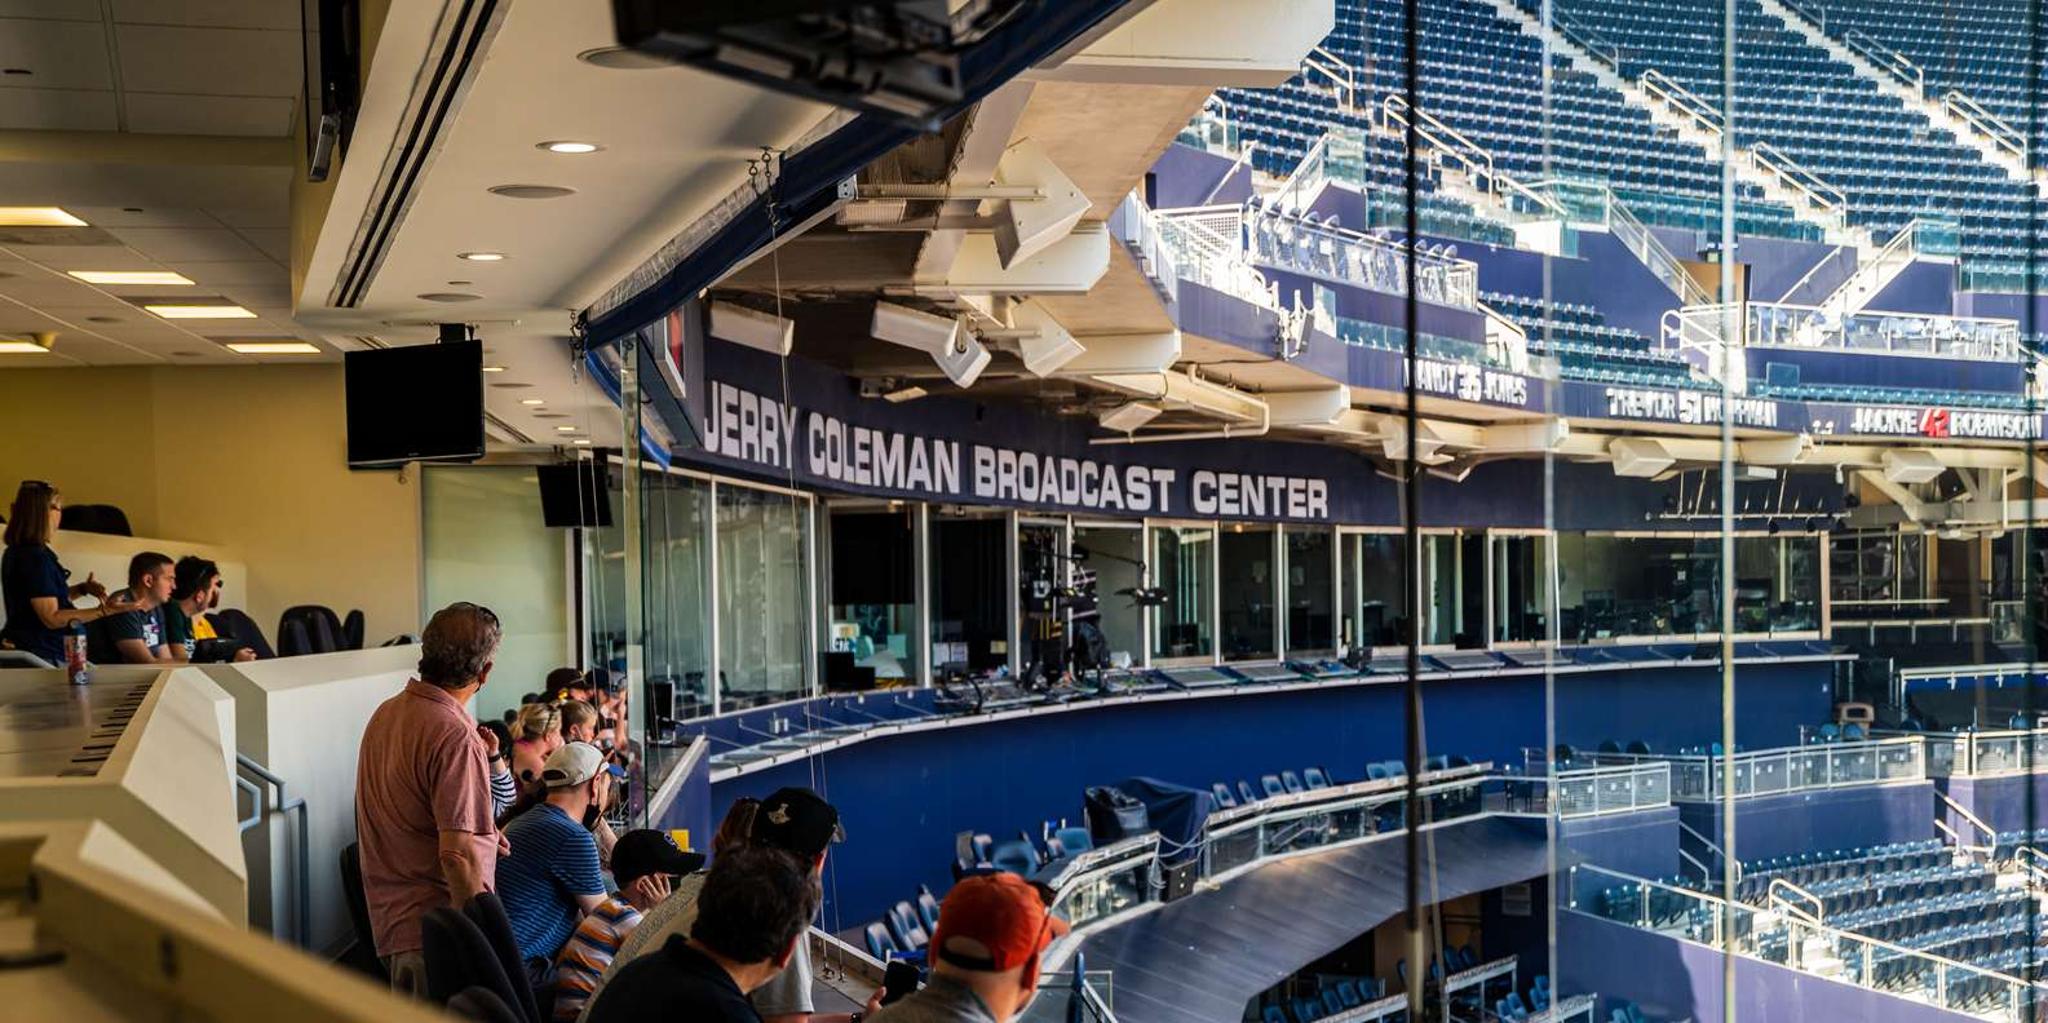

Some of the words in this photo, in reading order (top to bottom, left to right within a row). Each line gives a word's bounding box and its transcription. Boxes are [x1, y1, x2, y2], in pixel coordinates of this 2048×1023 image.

[1458, 364, 1482, 401] 35
[1484, 371, 1527, 405] JONES
[1605, 387, 1676, 420] TREVOR
[1678, 390, 1702, 424] 51
[1850, 407, 1918, 435] JACKIE
[1919, 407, 1949, 438] 42
[703, 381, 795, 469] JERRY
[809, 410, 960, 494] COLEMAN
[974, 444, 1175, 513] BROADCAST
[1192, 471, 1328, 518] CENTER
